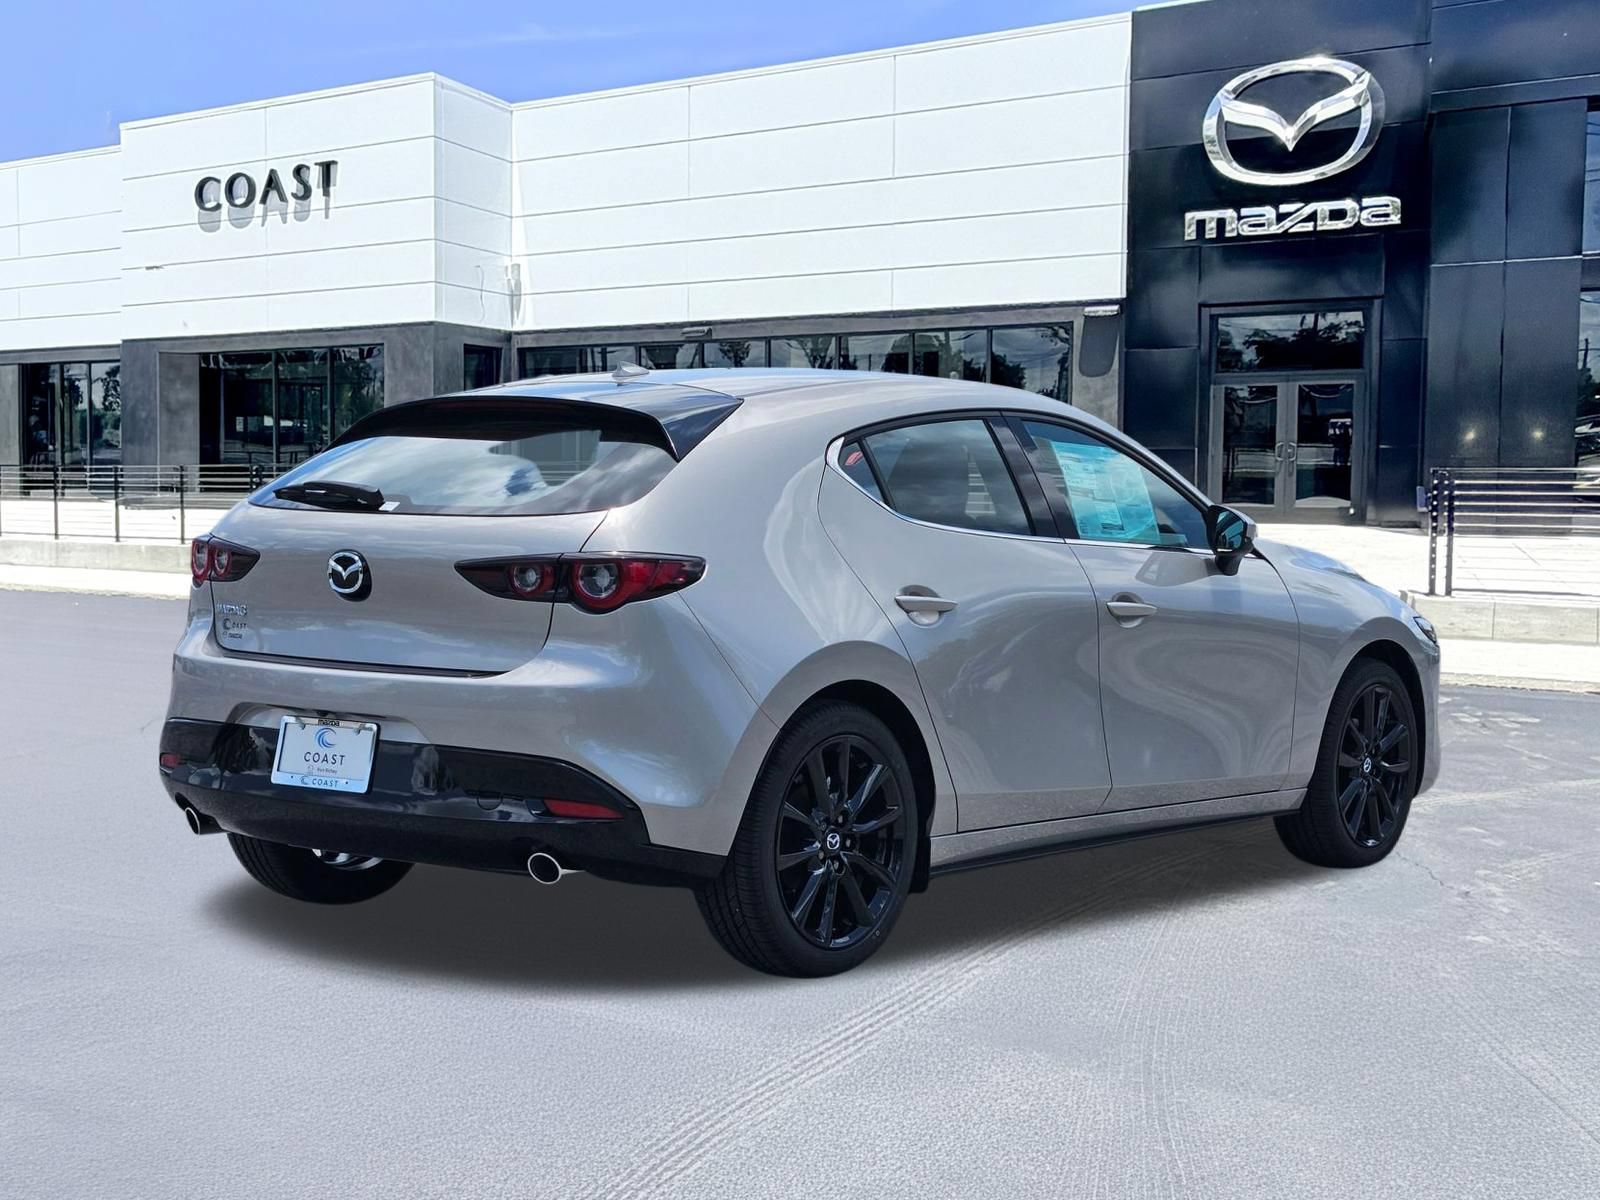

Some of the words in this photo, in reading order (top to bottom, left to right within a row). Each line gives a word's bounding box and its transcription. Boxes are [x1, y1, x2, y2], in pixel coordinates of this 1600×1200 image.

[195, 160, 338, 212] COAST
[1184, 196, 1401, 241] mazda
[304, 751, 346, 766] COAST
[312, 778, 338, 788] COAST
